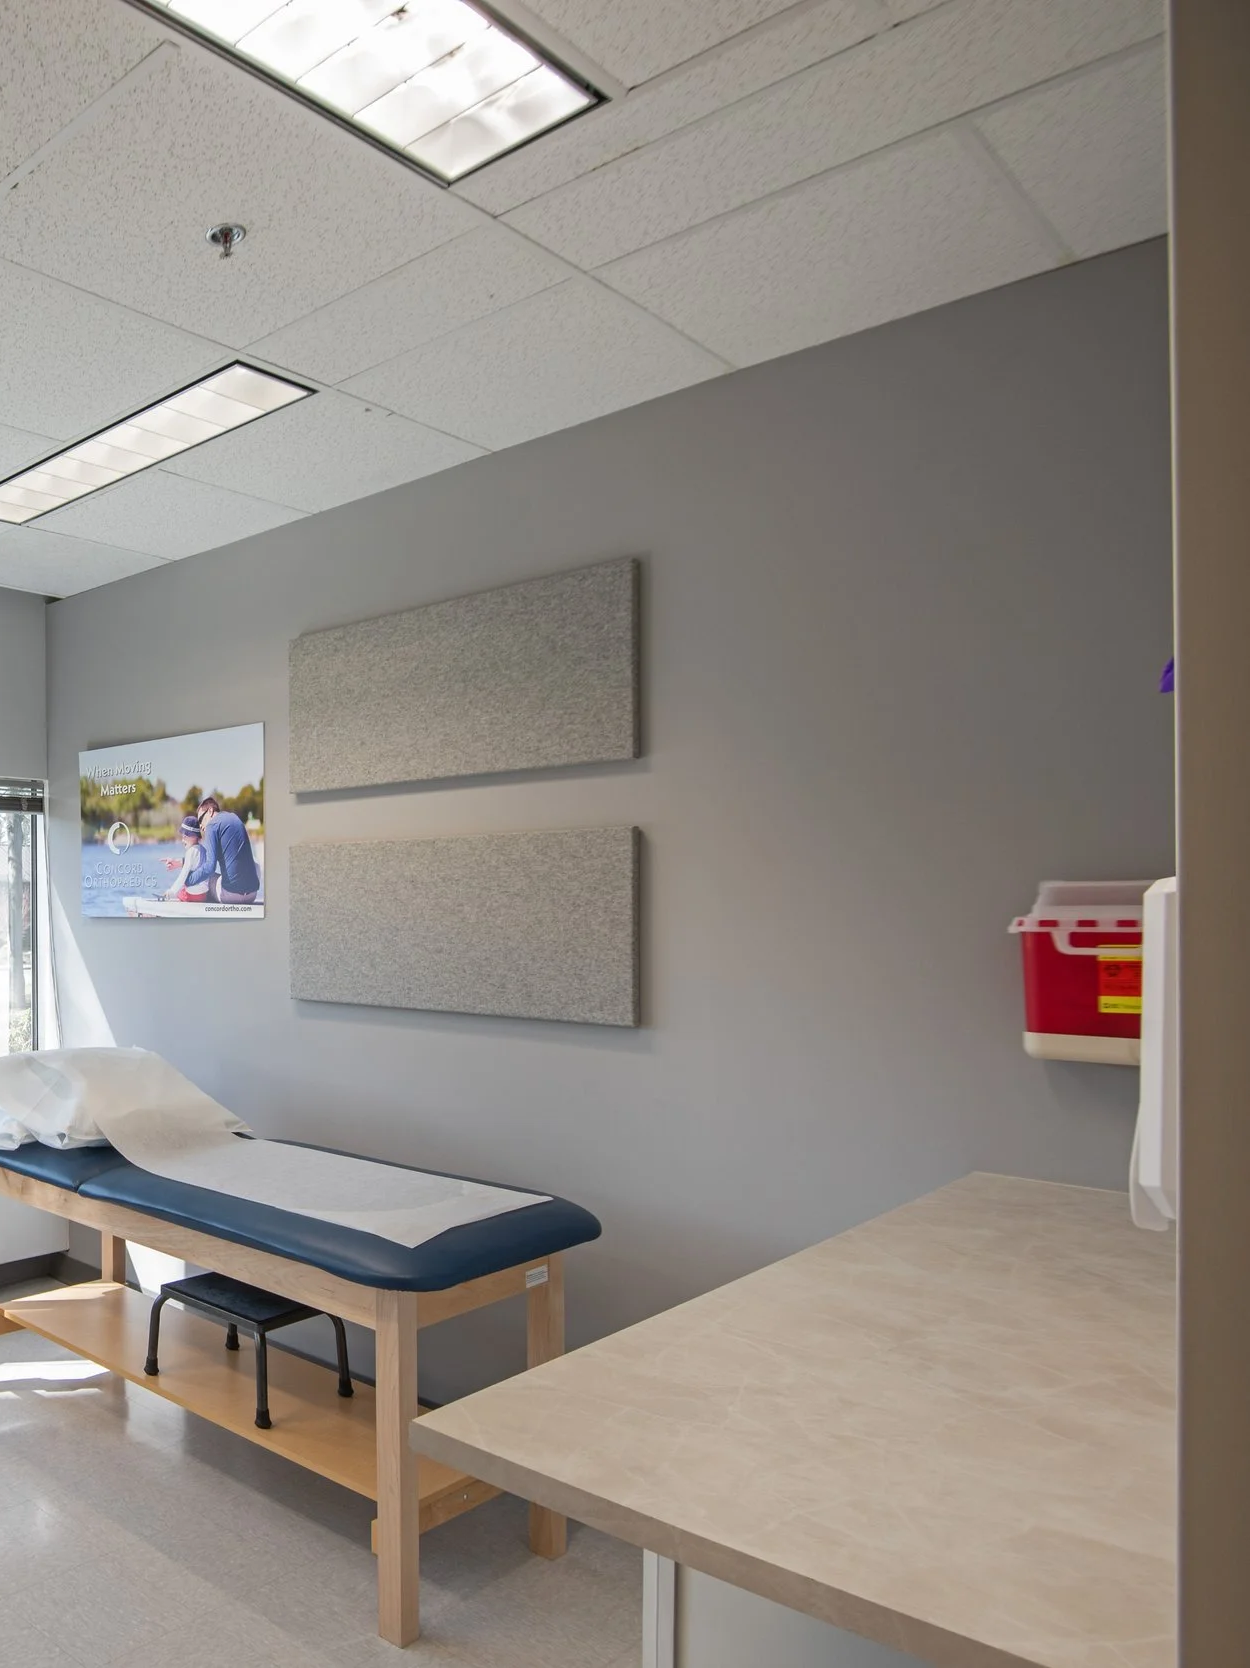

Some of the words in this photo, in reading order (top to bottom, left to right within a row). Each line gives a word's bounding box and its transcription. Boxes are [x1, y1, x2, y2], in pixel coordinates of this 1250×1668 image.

[86, 765, 114, 779] When
[115, 761, 152, 776] Moving
[100, 783, 137, 797] Matters
[96, 861, 143, 875] CONCORD
[85, 875, 158, 889] ORTHOPAEDICS
